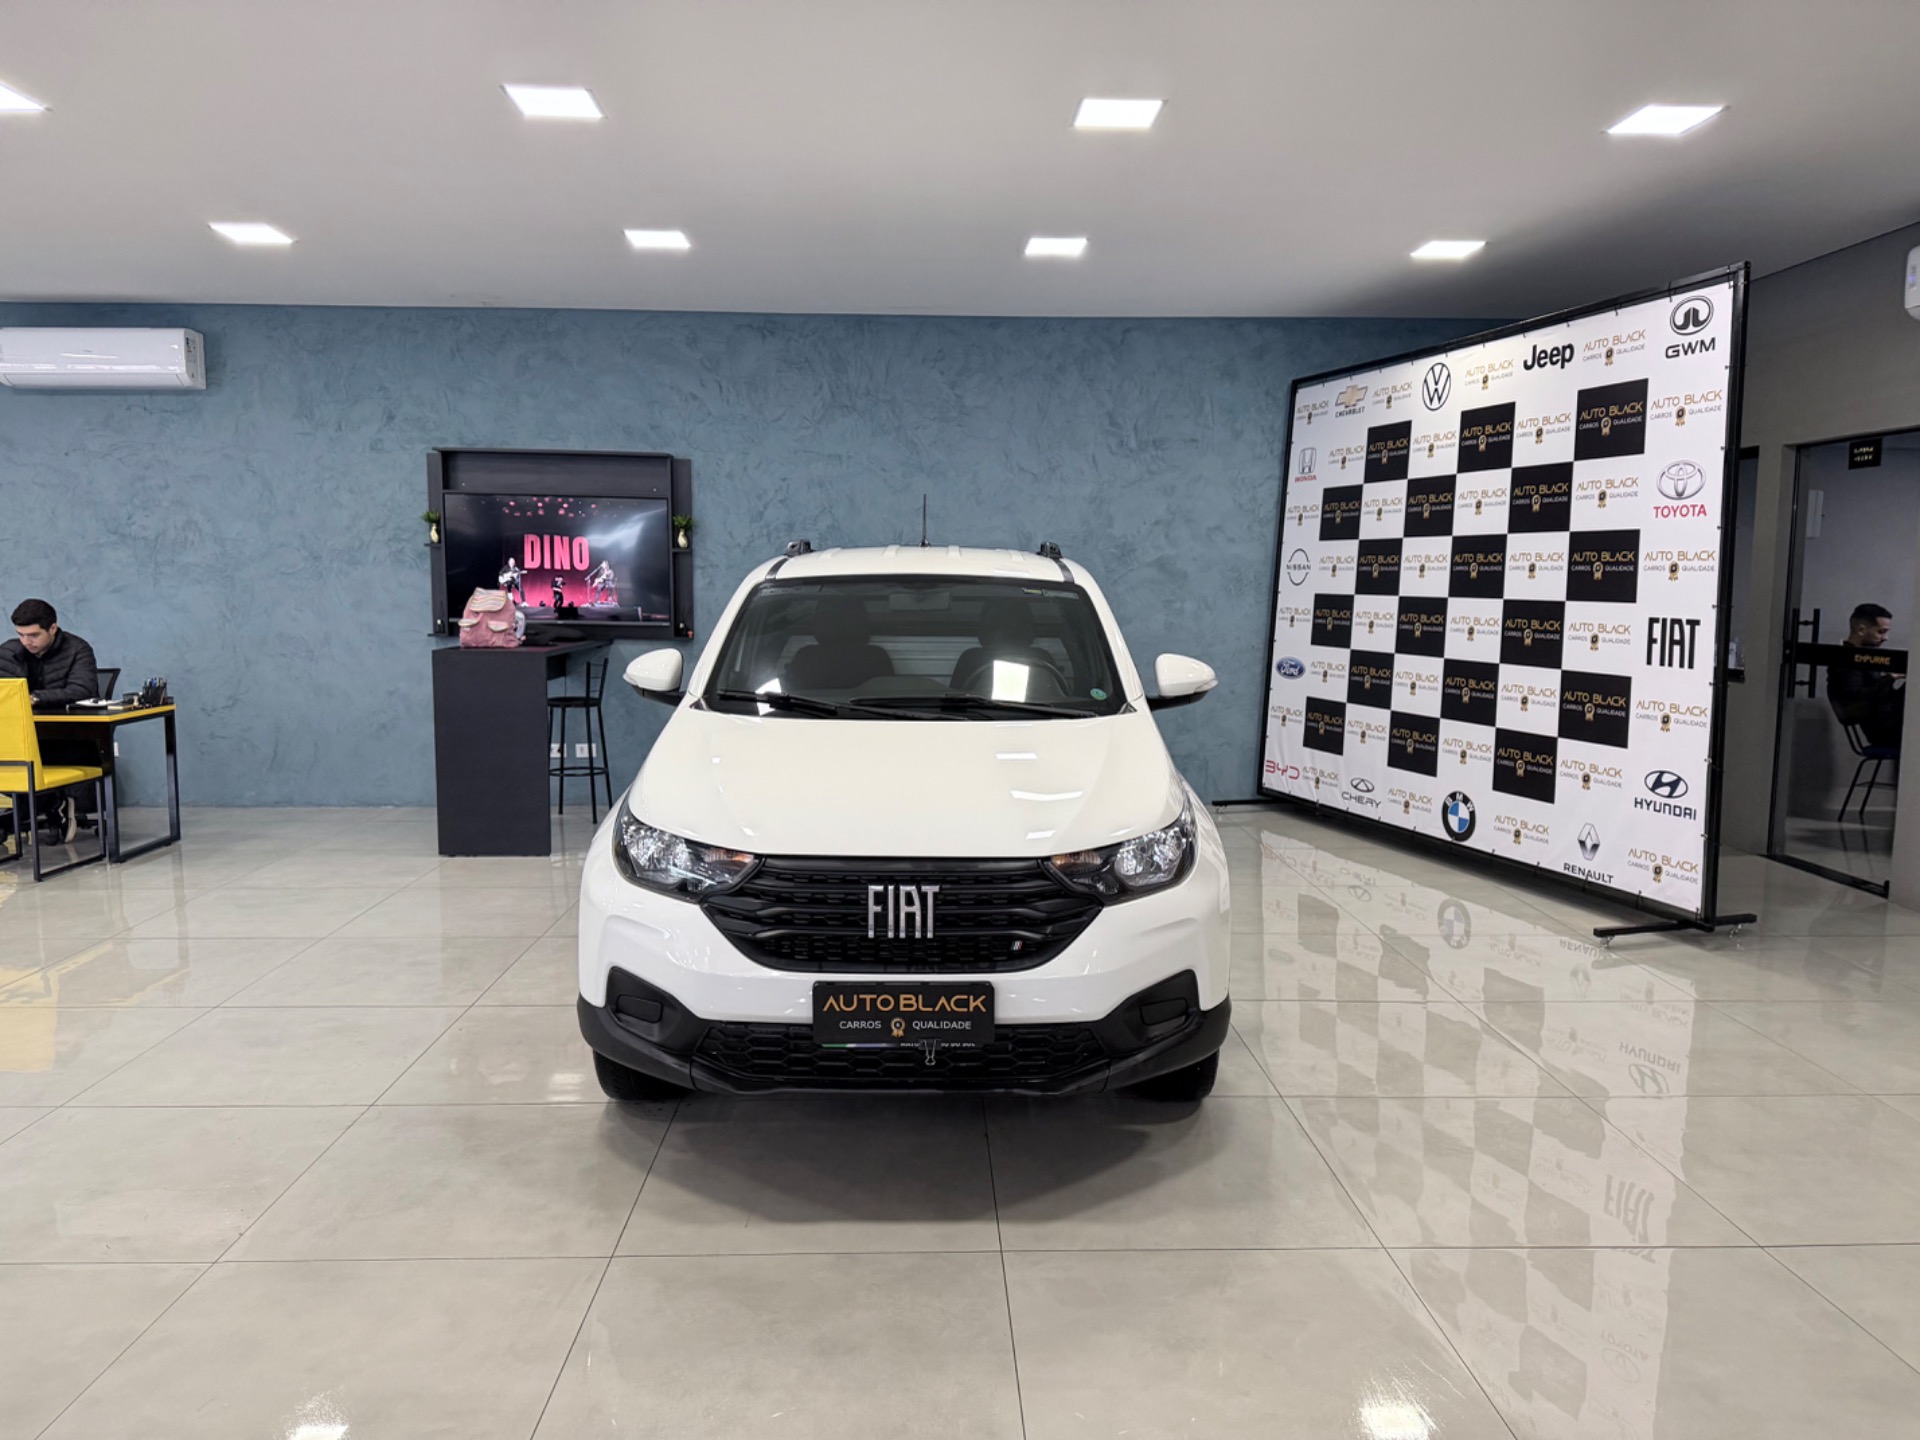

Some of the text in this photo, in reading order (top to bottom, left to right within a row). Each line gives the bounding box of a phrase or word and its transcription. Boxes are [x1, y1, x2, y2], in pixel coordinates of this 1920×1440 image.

[1583, 329, 1645, 352] AUTO BLACK
[1665, 337, 1716, 359] GWM
[1524, 343, 1574, 370] Jeep
[1465, 359, 1513, 378] AUTO BLACK
[1650, 388, 1723, 410] AUTO BLACK
[1335, 406, 1365, 418] CHEVROLET
[1579, 400, 1644, 420] AUTO BLACK
[1650, 403, 1722, 420] CARROS QUALIDADE
[1461, 420, 1512, 438] AUTO BLACK
[1516, 411, 1572, 430] AUTO BLACK
[1413, 429, 1457, 445] AUTO BLACK
[1295, 474, 1316, 483] HONDA
[1575, 476, 1638, 491] AUTO BLACK
[1458, 487, 1507, 500] AUTO BLACK
[1512, 481, 1569, 496] AUTO BLACK
[1408, 492, 1453, 504] AUTO BLACK
[1653, 504, 1707, 518] TOYOTA
[523, 534, 590, 571] DINO
[1404, 554, 1448, 563] AUTO BLACK
[1453, 552, 1503, 562] AUTO BLACK
[1509, 551, 1565, 562] AUTO BLACK
[1571, 550, 1636, 561] AUTO BLACK
[1643, 550, 1716, 561] AUTO BLACK
[1399, 613, 1444, 623] AUTO BLACK
[1450, 615, 1500, 626] AUTO BLACK
[1504, 618, 1561, 630] AUTO BLACK
[1567, 621, 1631, 634] AUTO BLACK
[1647, 617, 1700, 669] FIAT
[1395, 670, 1413, 680] AUTO
[1415, 672, 1439, 683] BLACK
[1445, 676, 1496, 690] AUTO BLACK
[1501, 683, 1557, 698] AUTO BLACK
[1563, 690, 1627, 707] AUTO BLACK
[1635, 699, 1708, 717] AUTO BLACK
[1635, 712, 1707, 727] CARROS QUALIDADE
[1391, 727, 1410, 738] AUTO
[1412, 730, 1437, 743] BLACK
[1442, 736, 1492, 754] AUTO BLACK
[1497, 746, 1554, 765] AUTO BLACK
[1265, 760, 1300, 780] BYD
[1559, 758, 1621, 778] AUTO BLACK
[1341, 792, 1381, 808] CHERY
[1389, 788, 1431, 805] AUTO BLACK
[1634, 797, 1696, 821] HYUNDAI
[1494, 814, 1549, 835] AUTO BLACK
[1628, 846, 1699, 874] AUTO BLACK
[1564, 862, 1614, 884] RENAULT
[1627, 859, 1698, 884] CARROS QUALIDADE
[868, 884, 940, 938] FIAT
[823, 994, 986, 1012] AUTO BLACK
[839, 1020, 972, 1030] CARROS QUALIDADE
